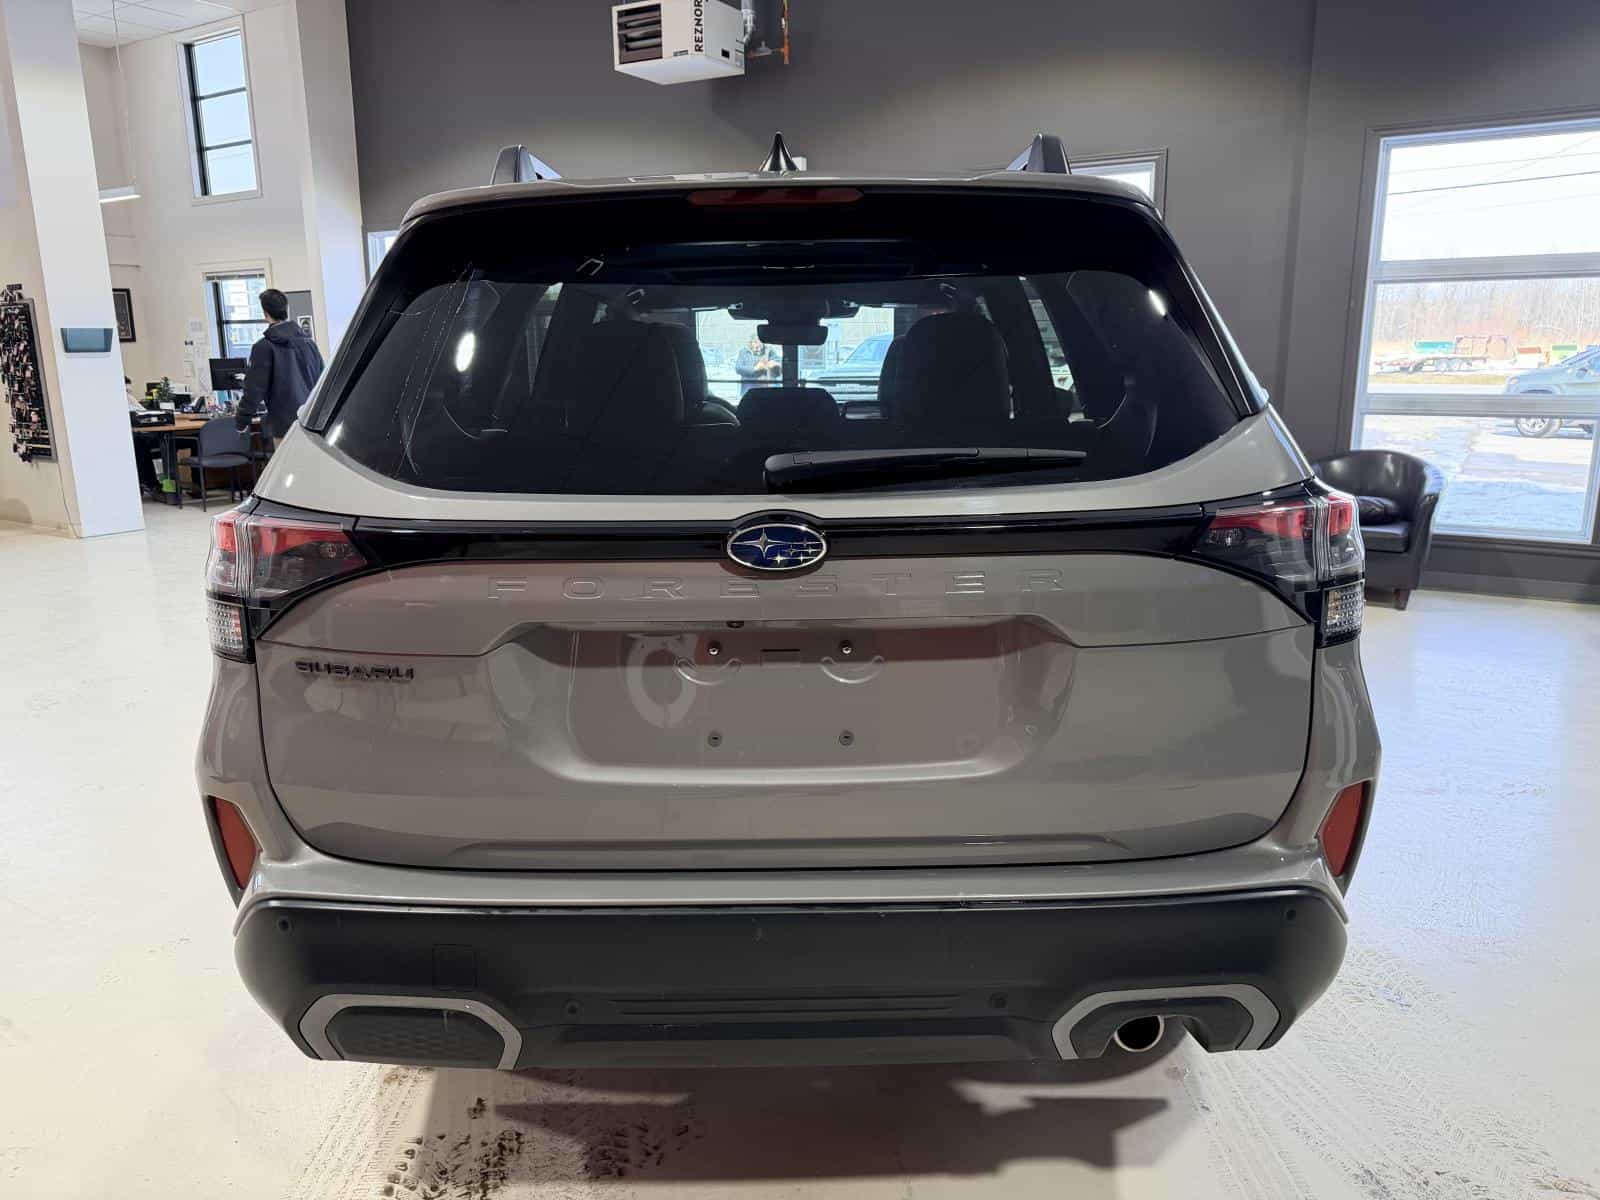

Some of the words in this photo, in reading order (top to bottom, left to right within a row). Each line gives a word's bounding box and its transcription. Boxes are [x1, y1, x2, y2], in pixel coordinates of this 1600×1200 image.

[694, 0, 704, 53] REZNOR
[487, 569, 1065, 601] FORESTER
[295, 661, 414, 681] SUBARU
